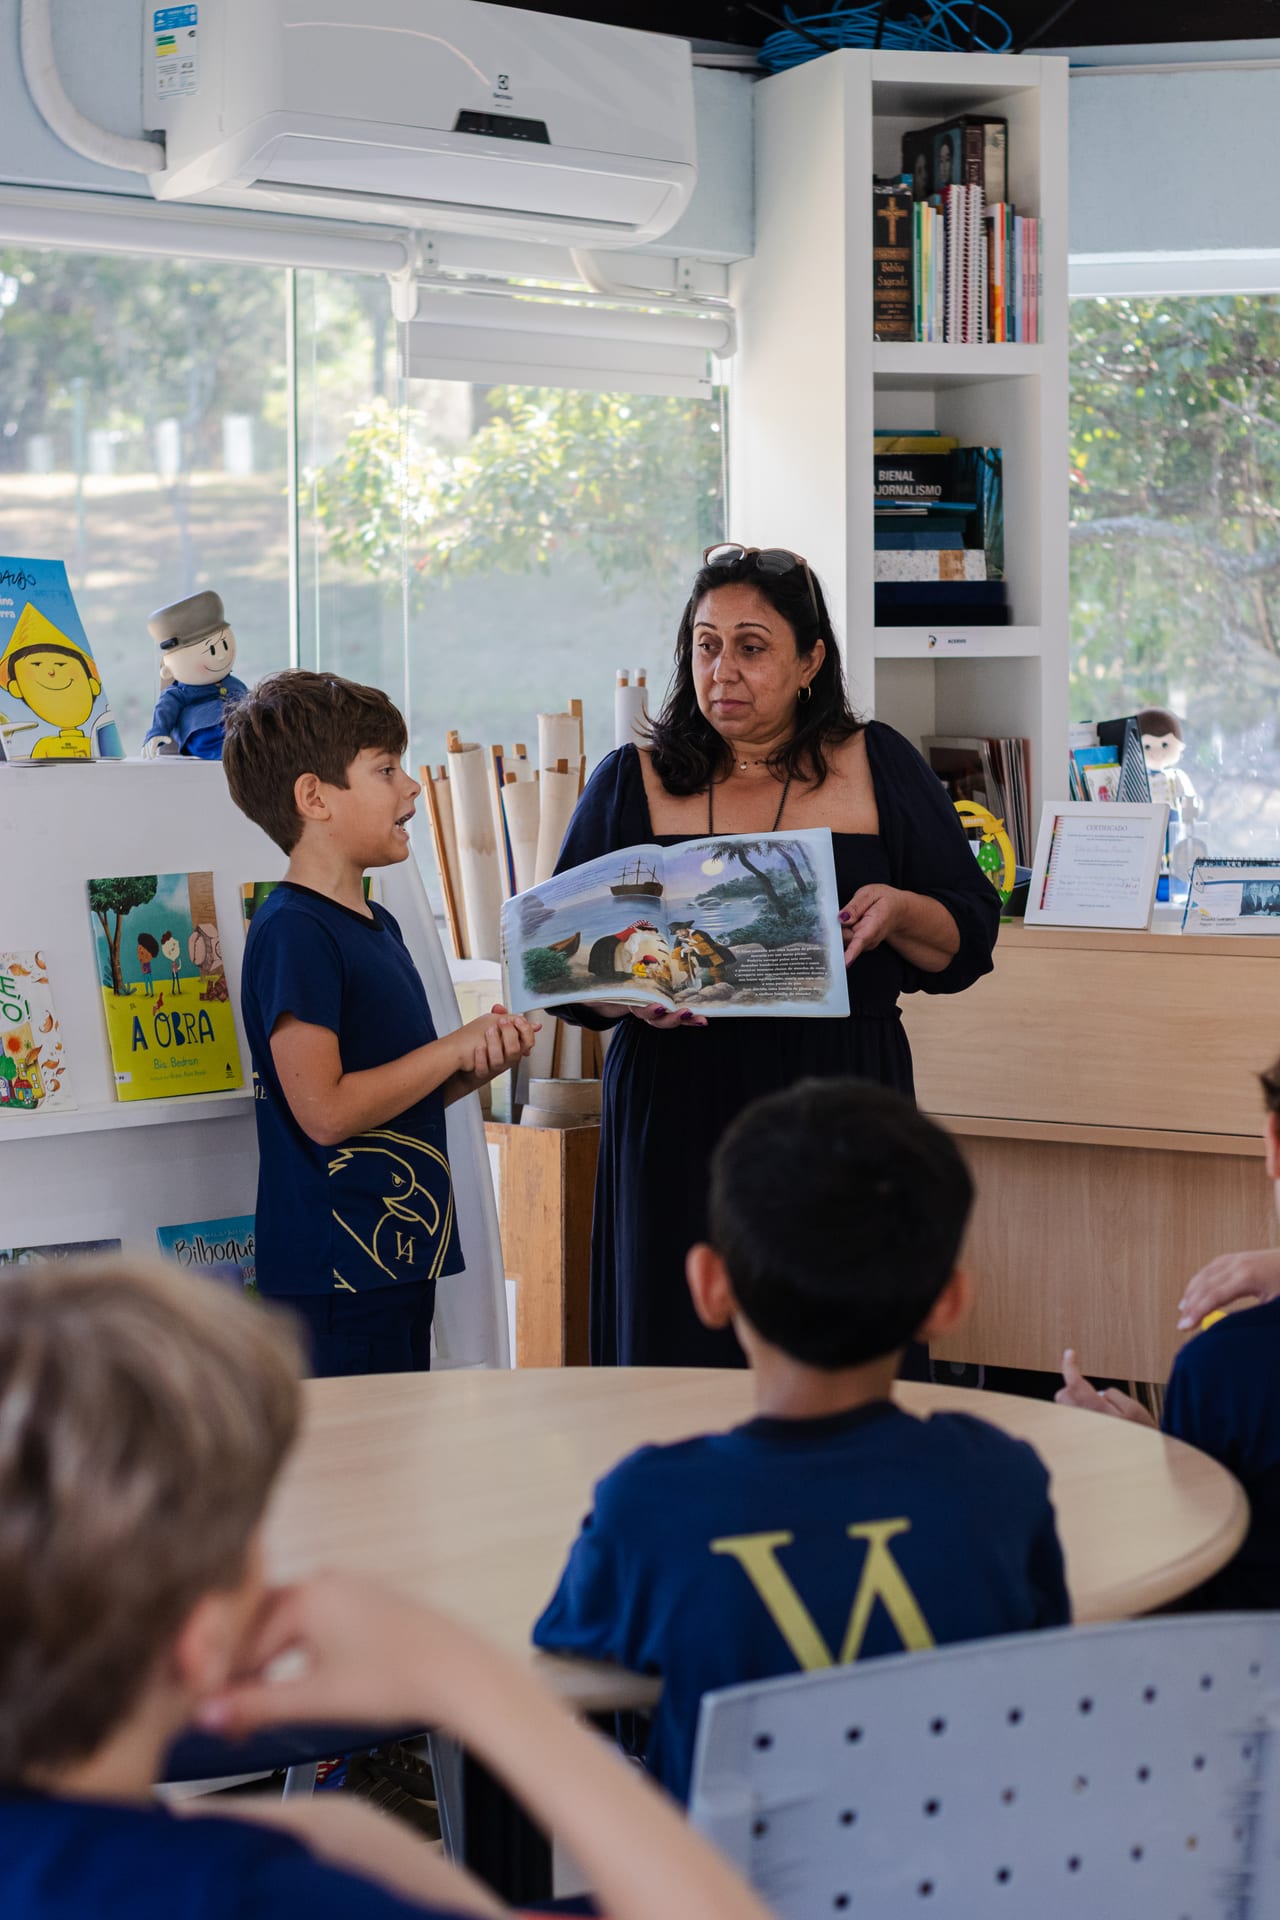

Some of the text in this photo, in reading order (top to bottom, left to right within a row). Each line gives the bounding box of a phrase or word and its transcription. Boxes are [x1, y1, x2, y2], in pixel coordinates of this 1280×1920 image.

[878, 470, 916, 482] BIENAL
[874, 485, 942, 496] JORNALISMO
[131, 1009, 215, 1052] A OBRA
[153, 1055, 199, 1070] Bia Bedran
